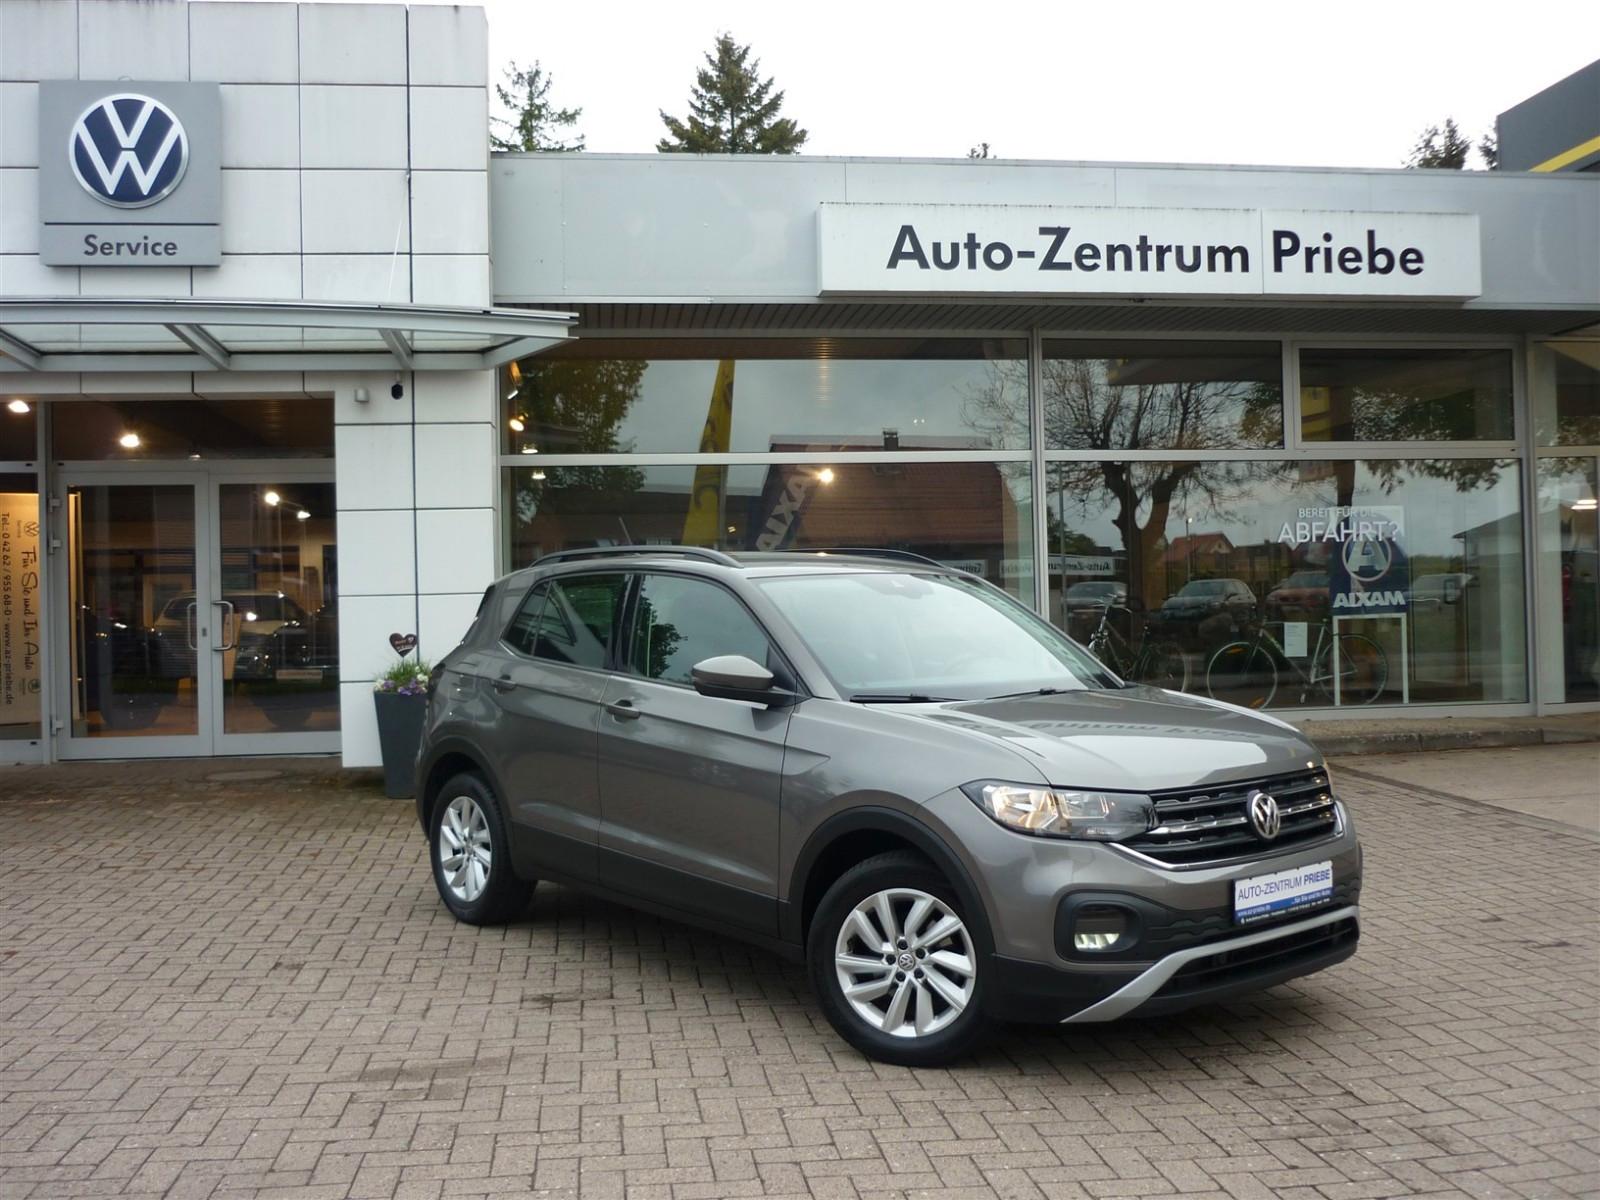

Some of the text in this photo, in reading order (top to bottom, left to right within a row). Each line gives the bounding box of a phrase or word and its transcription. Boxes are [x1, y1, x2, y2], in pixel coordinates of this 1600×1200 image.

[82, 234, 178, 256] Service
[886, 225, 1425, 276] Auto-Zentrum Priebe
[1277, 521, 1401, 544] ABFAHRT?
[1333, 590, 1406, 609] AIXAM
[1238, 876, 1303, 900] AUTO-ZENTRUM
[1304, 869, 1330, 885] PRIEBE
